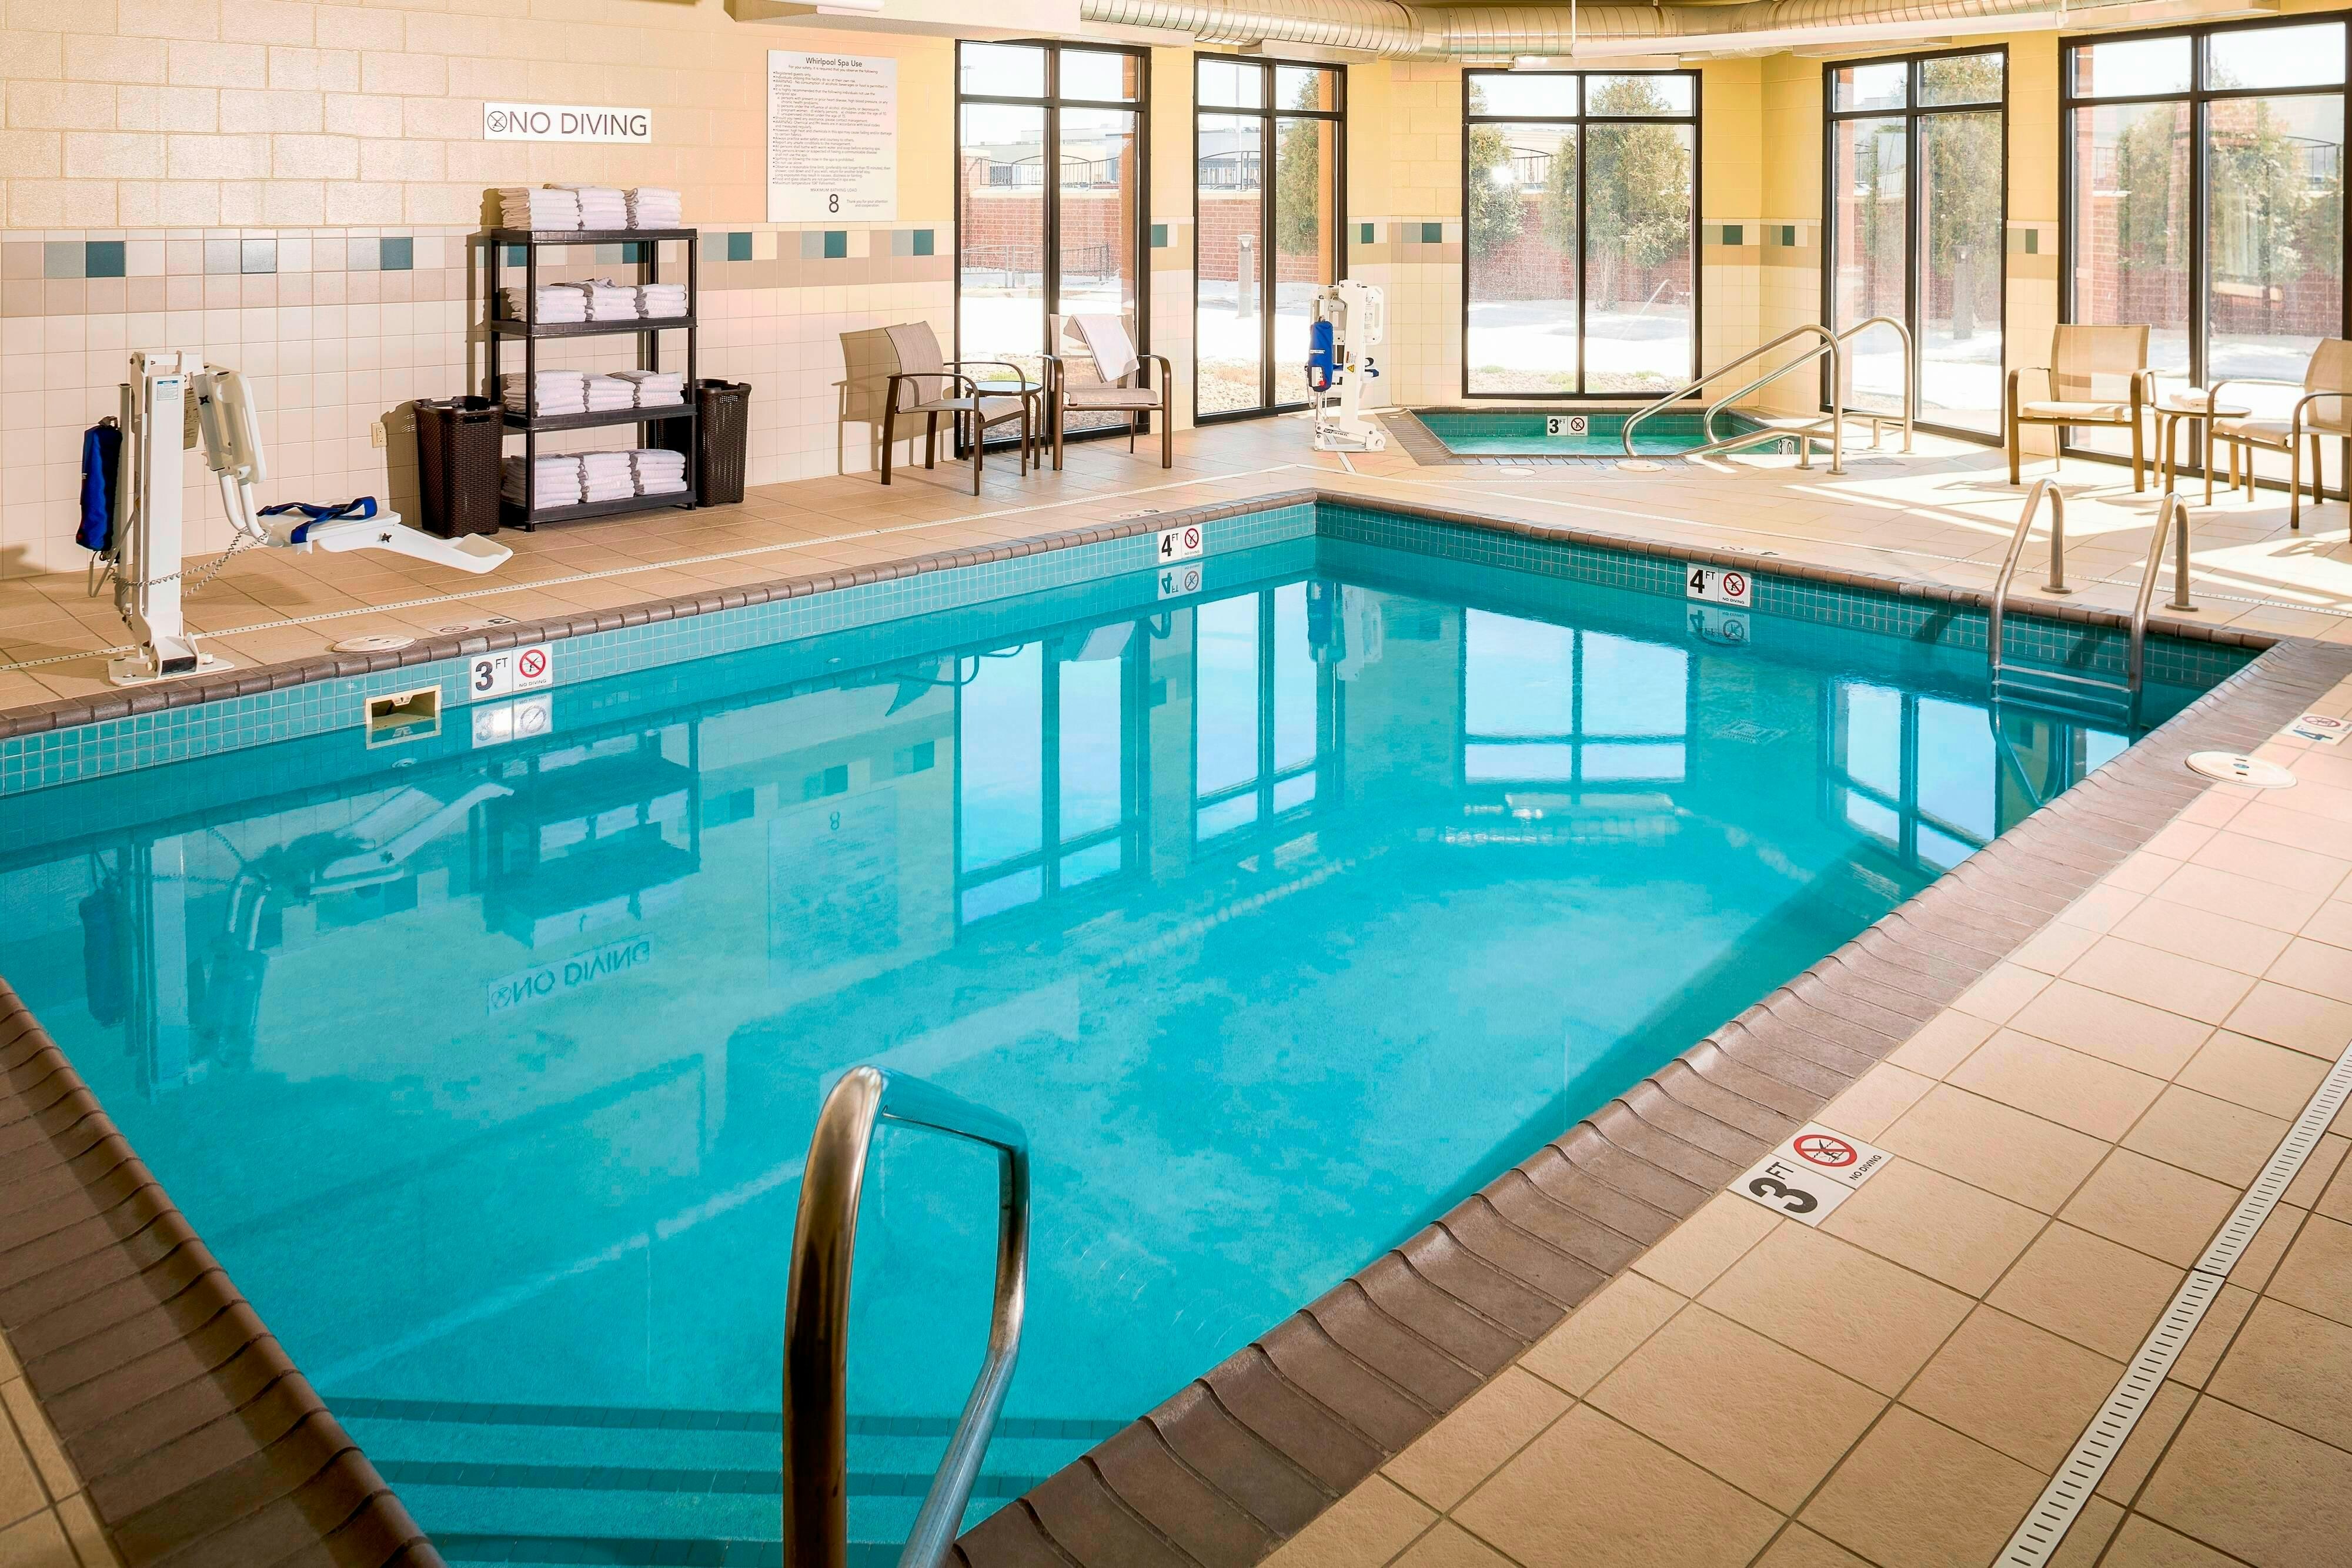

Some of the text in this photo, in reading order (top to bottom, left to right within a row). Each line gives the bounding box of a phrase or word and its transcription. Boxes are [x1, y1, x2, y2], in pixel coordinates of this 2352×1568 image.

[806, 57, 836, 66] Whirlpool
[838, 59, 849, 68] Spa
[509, 111, 647, 136] NO DIVING
[829, 193, 839, 213] 8
[1549, 419, 1559, 434] 3
[1779, 439, 1782, 454] 3
[1161, 534, 1172, 557] 4
[1689, 569, 1715, 594] 4 FT
[476, 657, 509, 691] 3 FT
[2293, 729, 2333, 740] 4
[1849, 1154, 1882, 1181] NO DIVING
[1749, 1161, 1818, 1213] 3 FT
